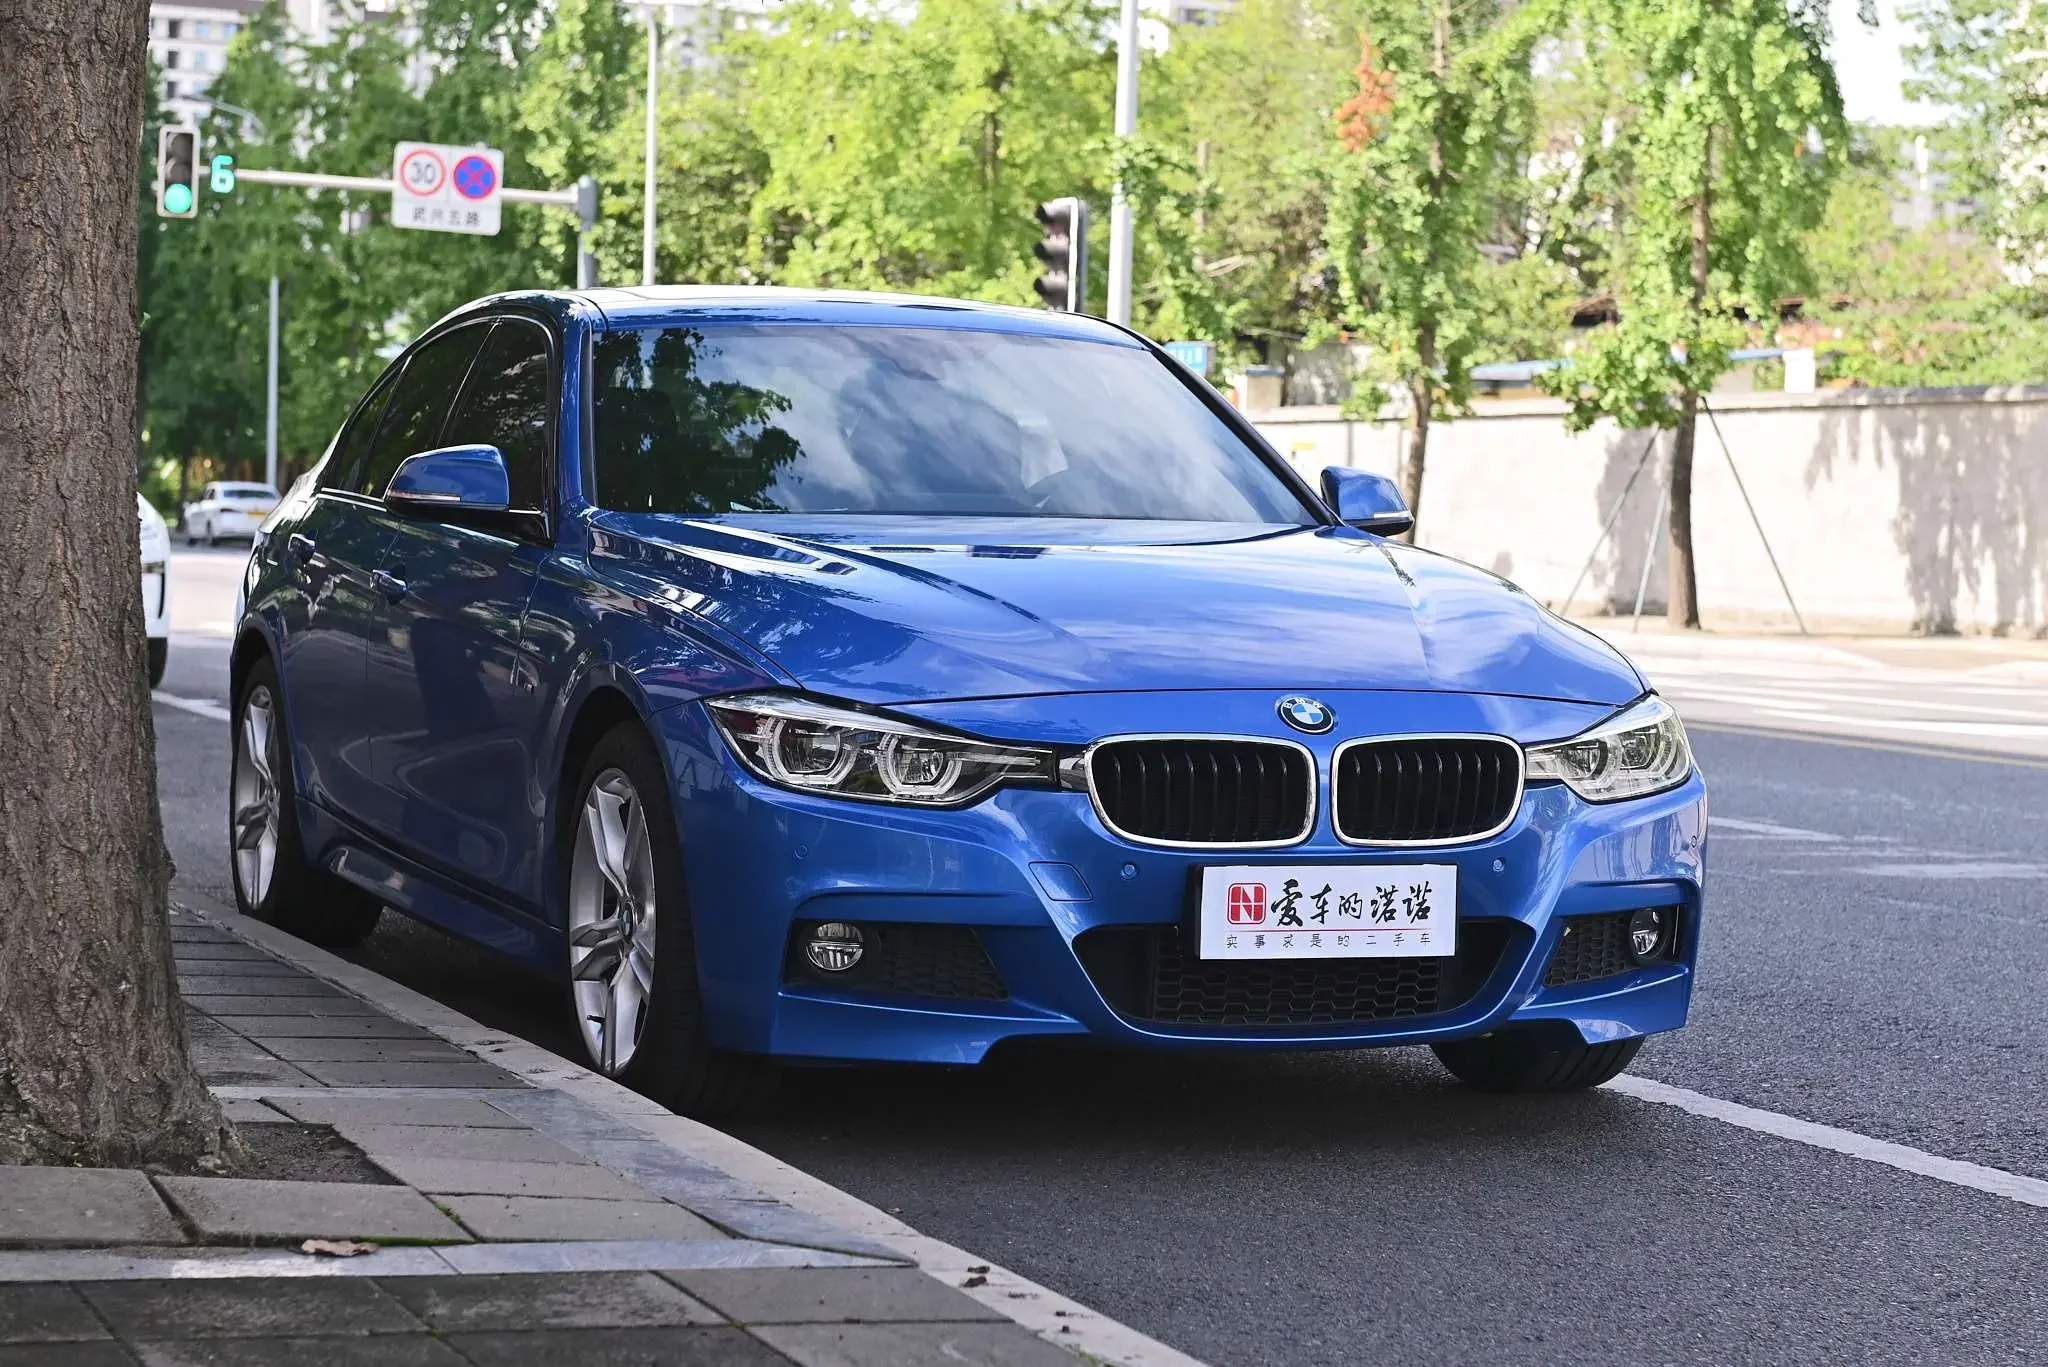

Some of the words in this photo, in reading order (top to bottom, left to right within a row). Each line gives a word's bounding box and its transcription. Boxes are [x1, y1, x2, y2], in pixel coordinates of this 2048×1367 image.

[211, 155, 235, 193] 6
[411, 162, 436, 184] 30
[1227, 932, 1431, 949] 实事求是的二手车
